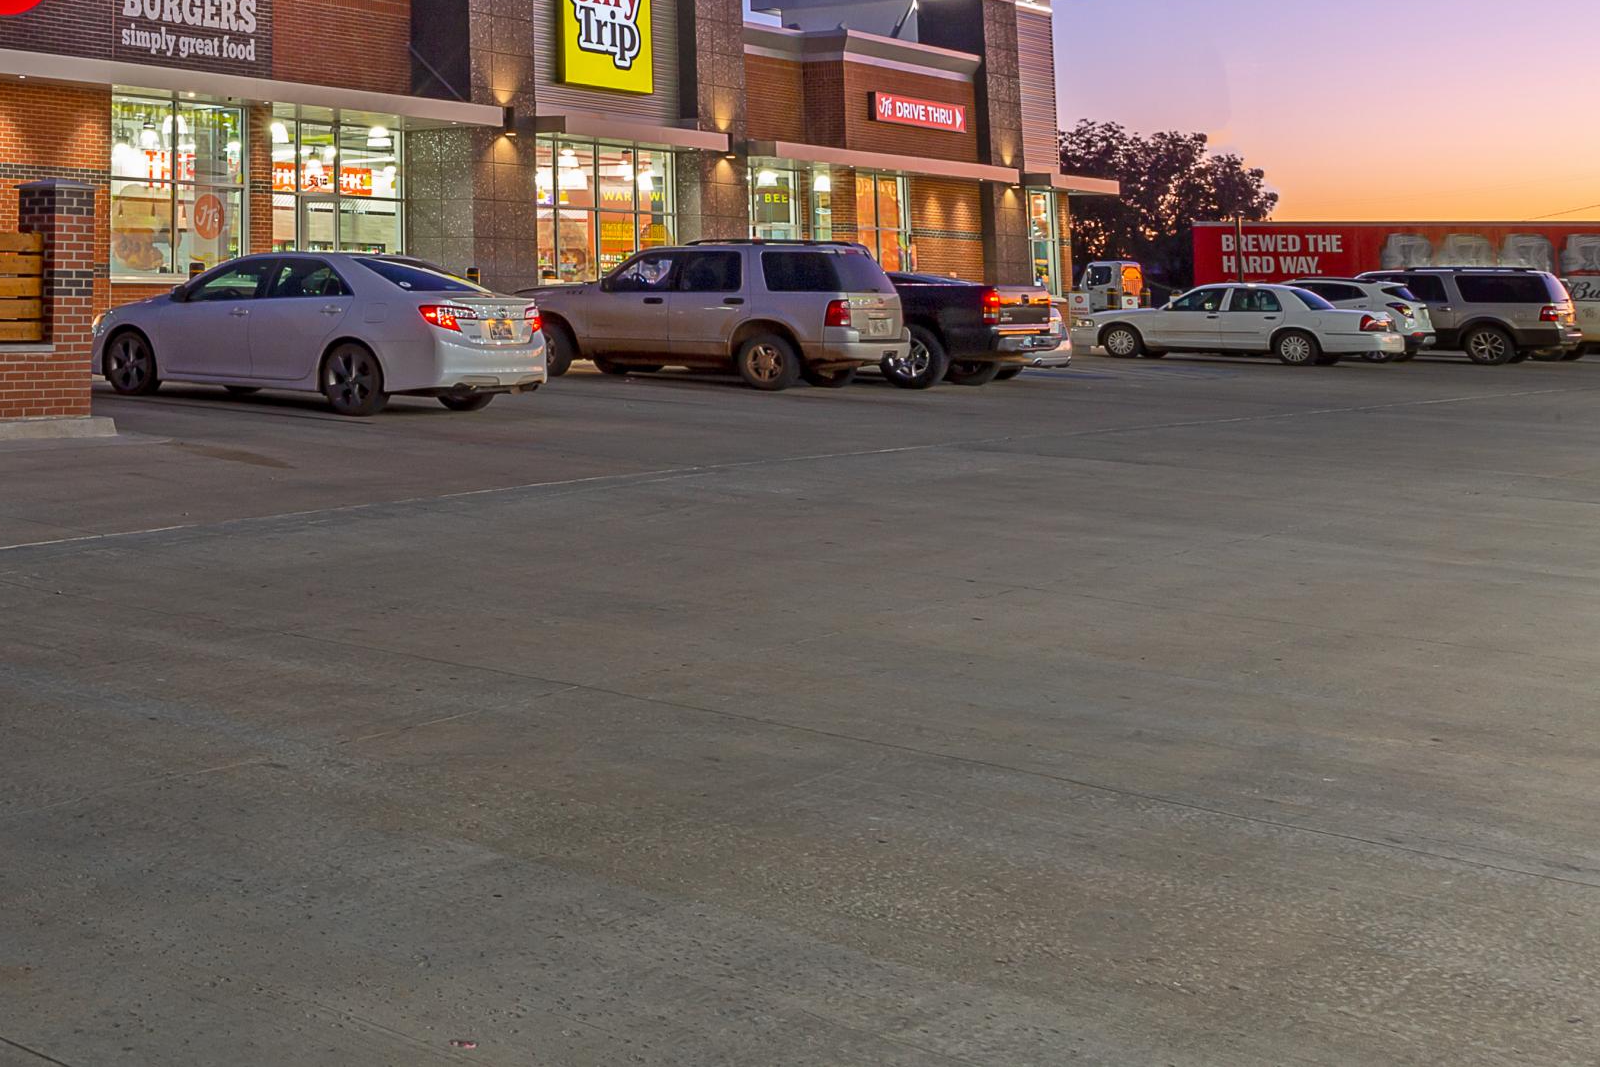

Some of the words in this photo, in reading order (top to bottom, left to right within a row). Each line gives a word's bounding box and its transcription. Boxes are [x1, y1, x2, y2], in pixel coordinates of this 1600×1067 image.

[121, 24, 175, 52] simply
[179, 35, 219, 59] great
[222, 36, 256, 61] food
[579, 5, 637, 62] Trip
[895, 102, 926, 121] DRIVE
[927, 106, 952, 125] THRU
[1221, 234, 1301, 252] BREWED
[1305, 234, 1343, 252] THE
[1222, 255, 1275, 273] HARD
[1279, 256, 1322, 274] WAY.
